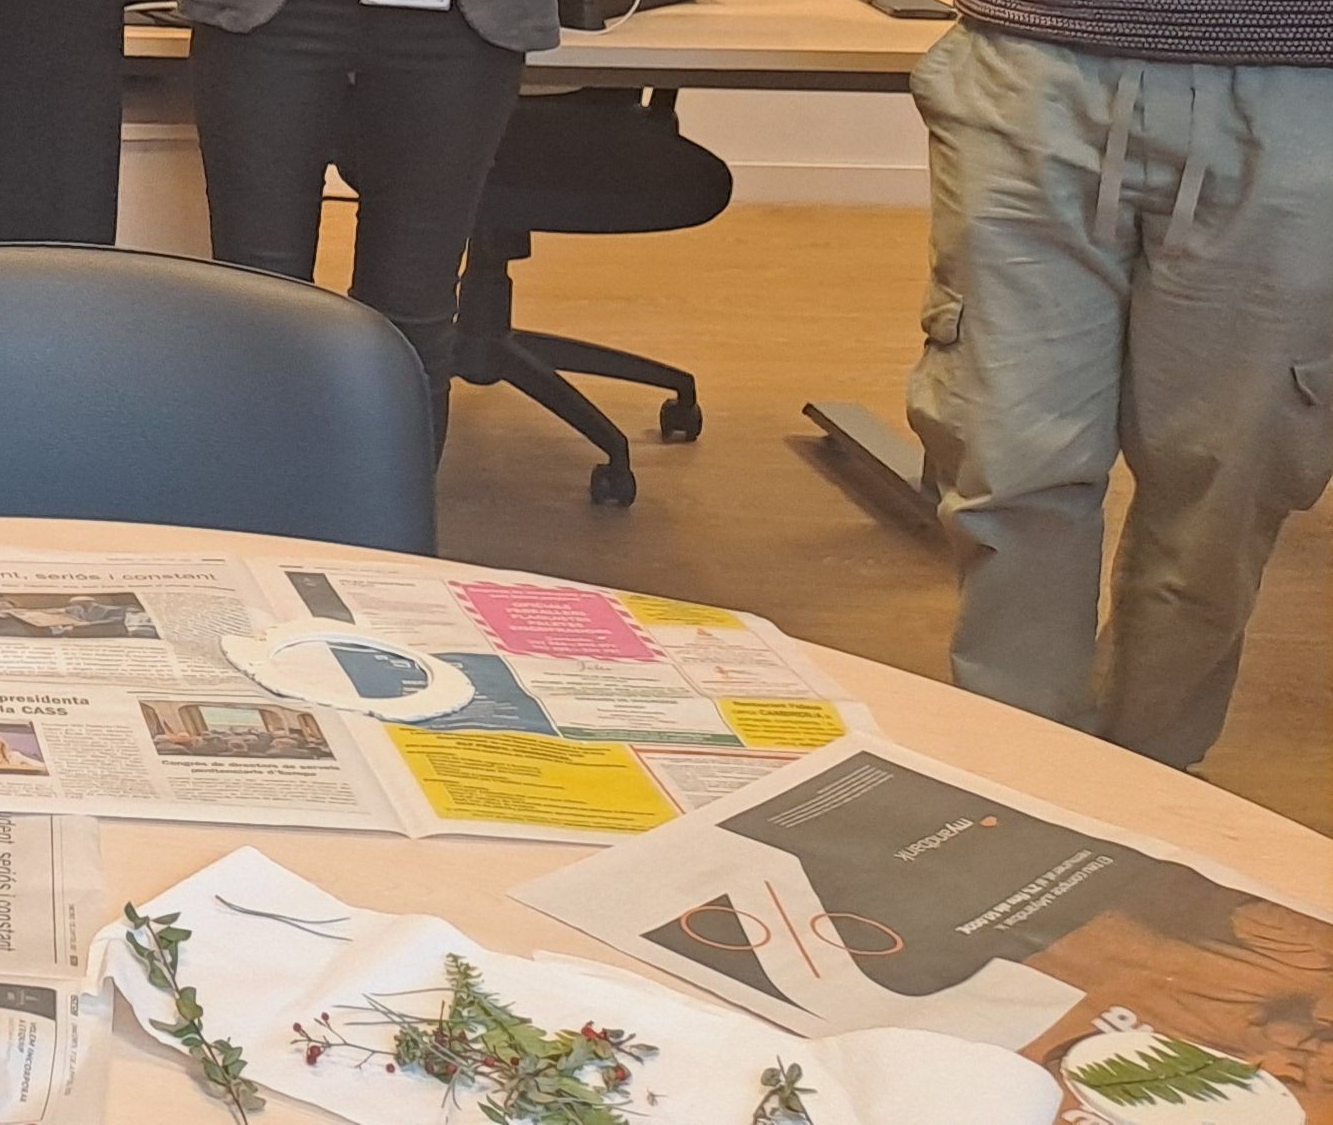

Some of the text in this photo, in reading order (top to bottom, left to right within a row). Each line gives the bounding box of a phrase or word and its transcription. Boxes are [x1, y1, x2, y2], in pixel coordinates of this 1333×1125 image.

[122, 572, 217, 583] constant
[0, 694, 90, 706] presidenta
[0, 704, 15, 714] la
[22, 705, 68, 716] CASS
[894, 818, 974, 862] myandbank
